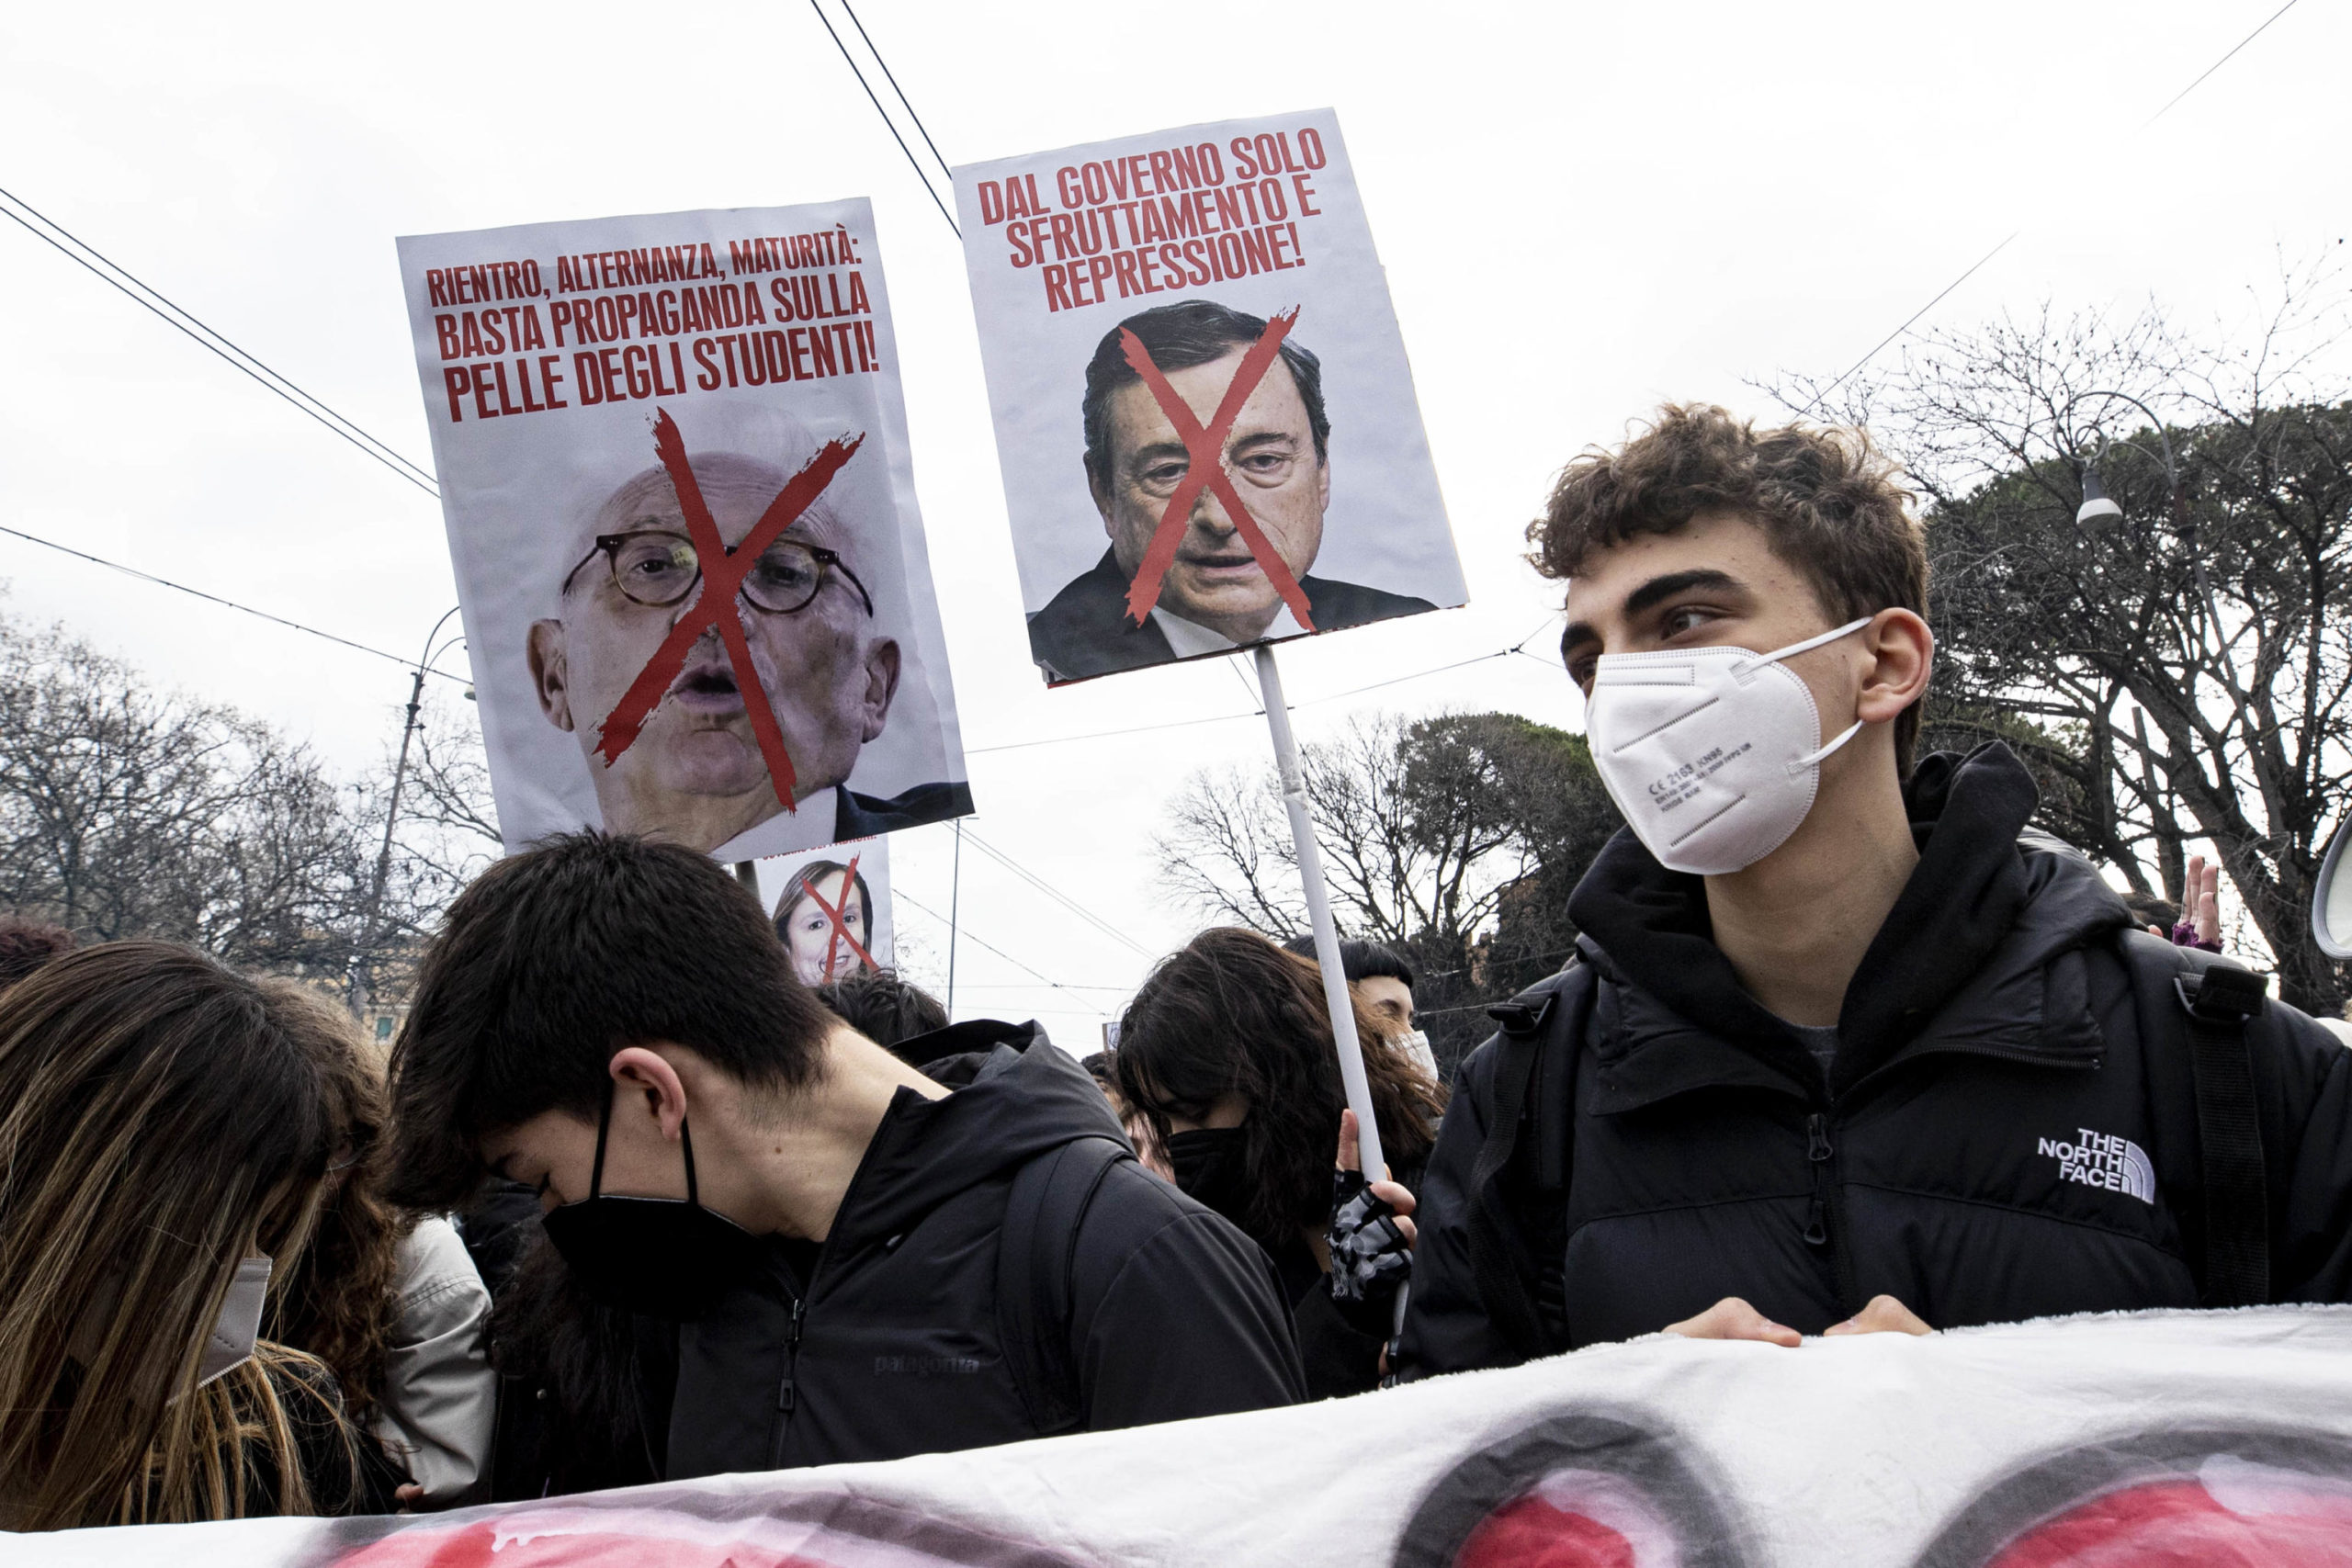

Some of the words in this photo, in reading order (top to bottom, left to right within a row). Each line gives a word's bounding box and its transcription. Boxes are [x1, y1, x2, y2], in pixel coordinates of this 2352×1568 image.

[978, 174, 1051, 225] DAL
[1057, 143, 1224, 209] GOVERNO
[1230, 129, 1326, 179] SOLO
[1007, 178, 1288, 267] SFRUTTAMENTO
[1292, 174, 1320, 216] E
[426, 259, 549, 306] RIENTRO,
[559, 243, 725, 292] ALTERNANZA,
[729, 224, 862, 275] MATURITÀ:
[1043, 222, 1305, 312] REPRESSIONE!
[435, 305, 546, 360] BASTA
[549, 282, 766, 347] PROPAGANDA
[772, 272, 871, 322] SULLA
[445, 355, 568, 422] PELLE
[573, 342, 686, 406] DEGLI
[694, 321, 879, 390] STUDENTI!
[2037, 1137, 2123, 1173] NORTH
[2059, 1161, 2121, 1192] FACE
[2077, 1127, 2126, 1156] THE
